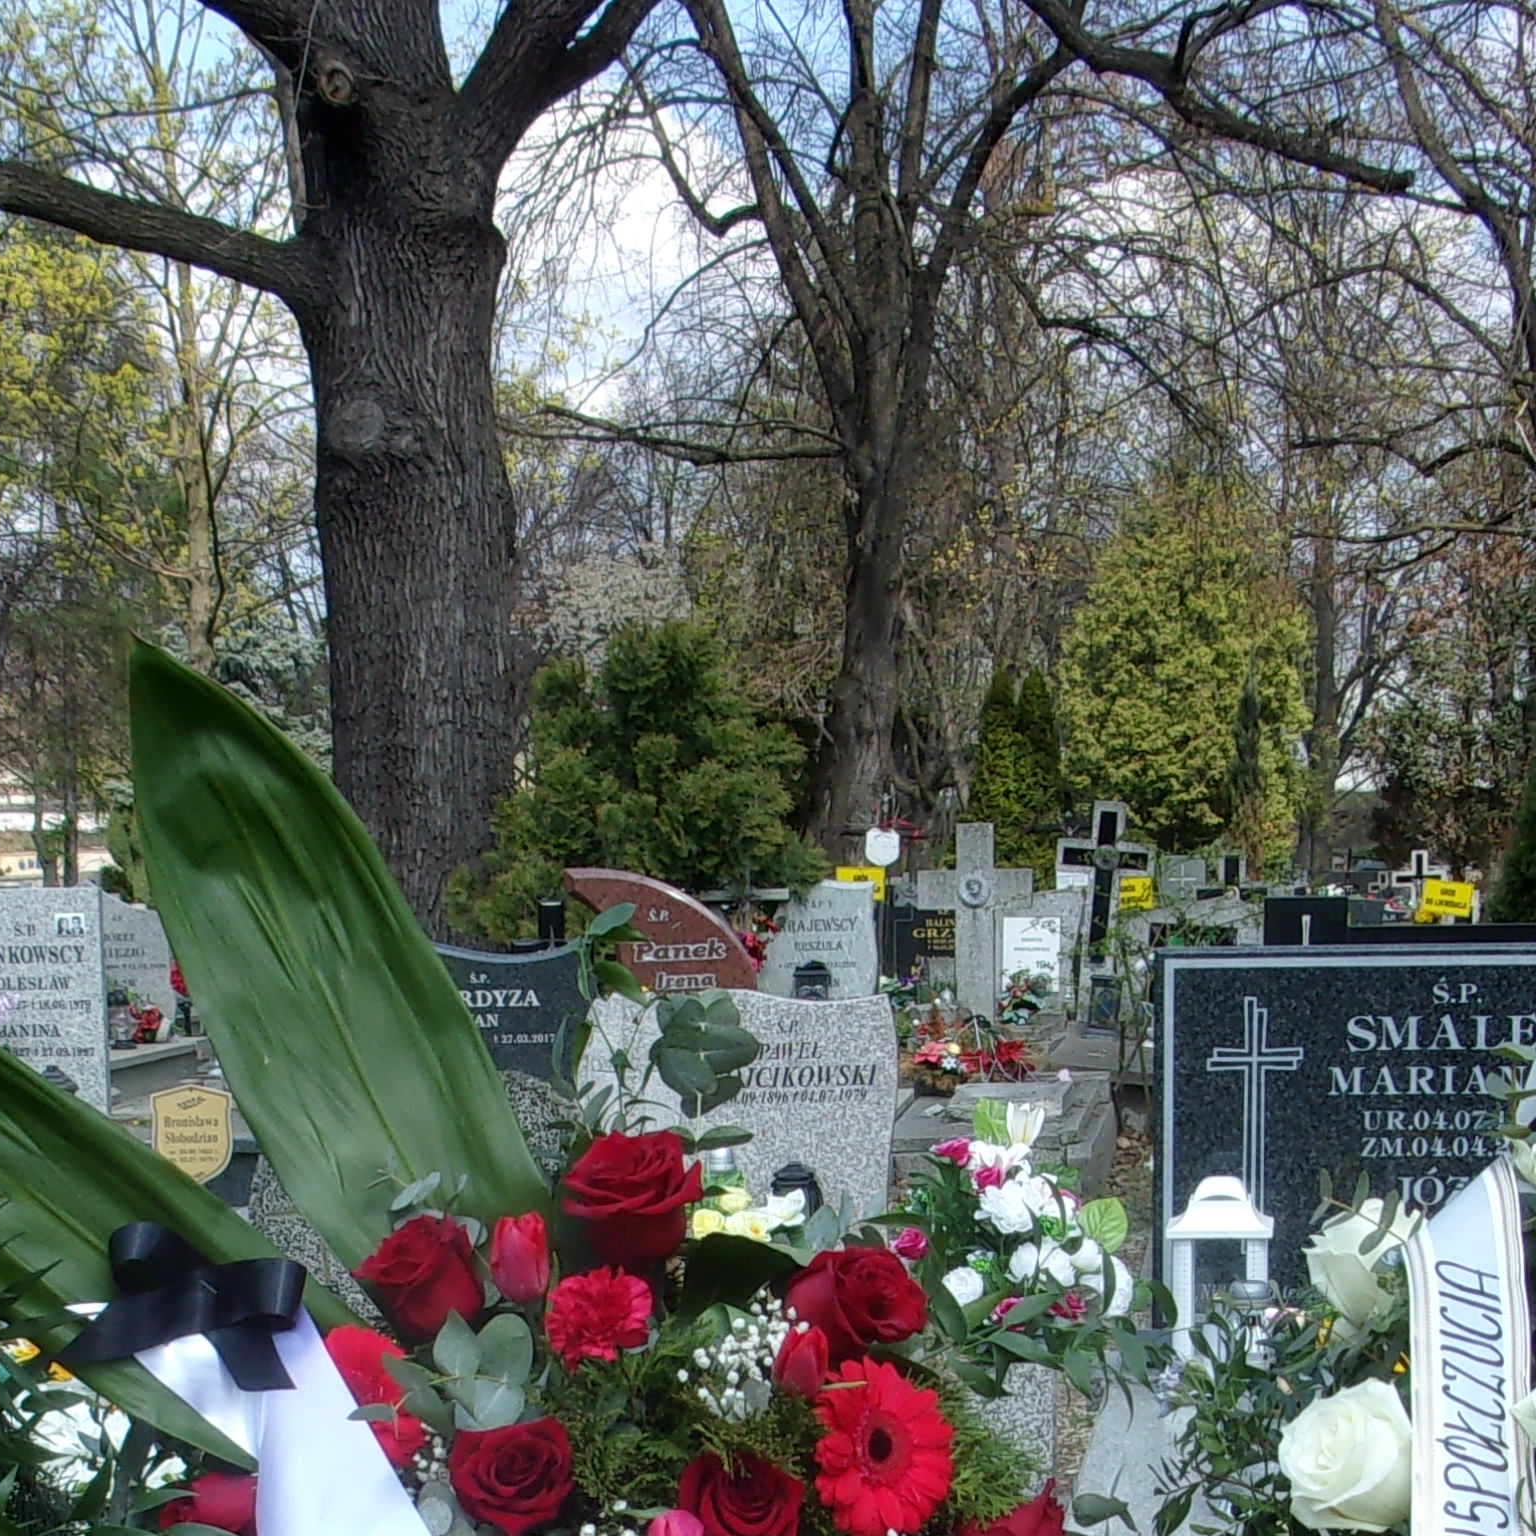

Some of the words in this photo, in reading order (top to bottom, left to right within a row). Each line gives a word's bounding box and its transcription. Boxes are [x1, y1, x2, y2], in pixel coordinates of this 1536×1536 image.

[633, 938, 728, 962] Panek
[655, 971, 717, 990] Irena
[458, 989, 541, 1008] RDYZA
[1432, 978, 1482, 1004] Ś.P.
[470, 1013, 499, 1028] AN
[501, 1033, 555, 1044] 27.03.2017
[735, 1063, 876, 1088] JCIKOWSKI
